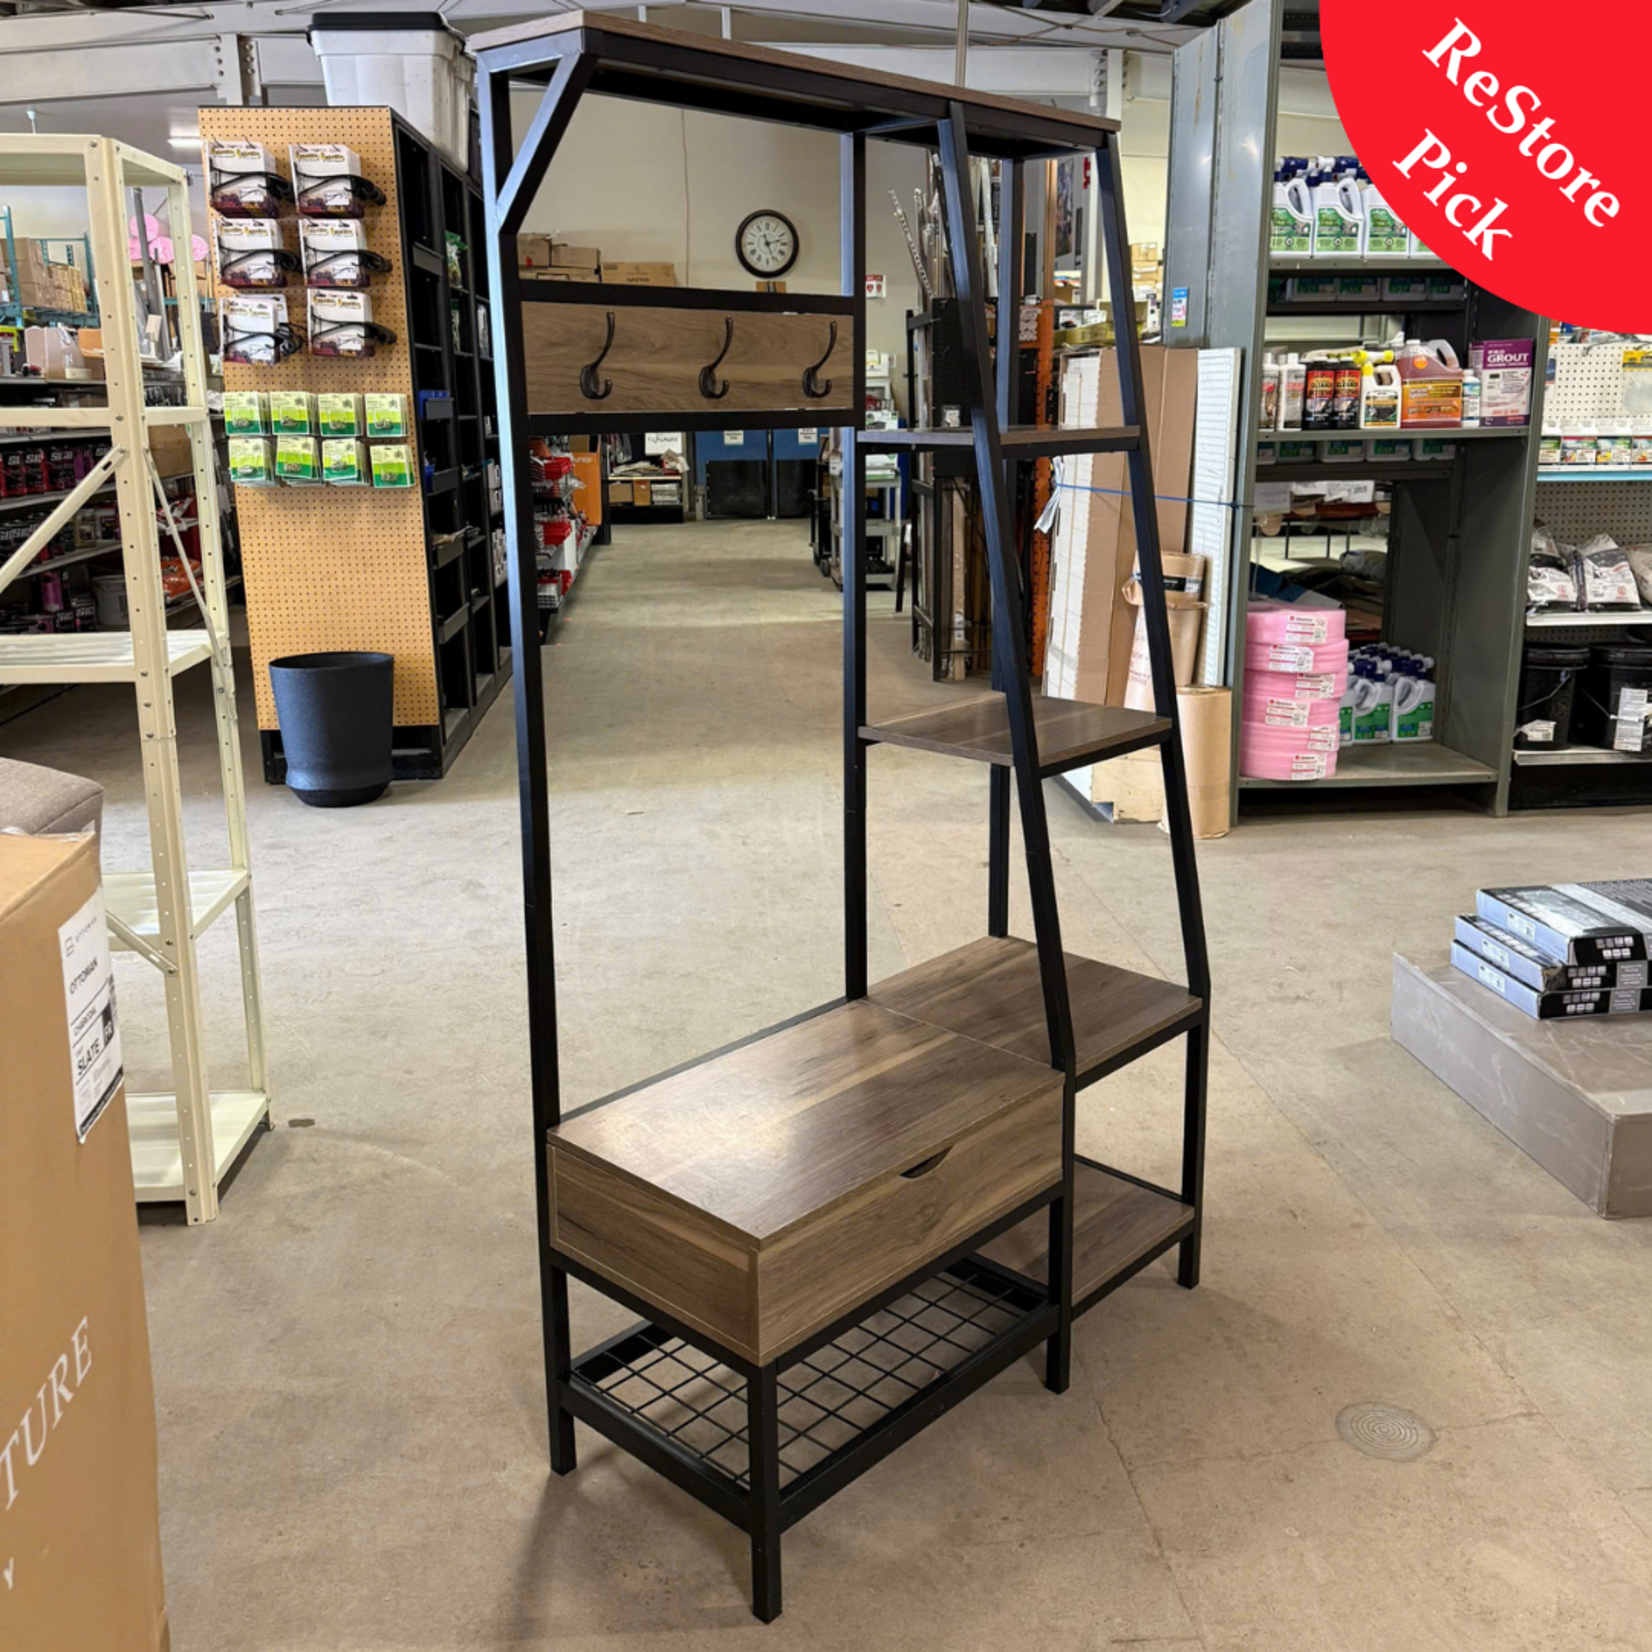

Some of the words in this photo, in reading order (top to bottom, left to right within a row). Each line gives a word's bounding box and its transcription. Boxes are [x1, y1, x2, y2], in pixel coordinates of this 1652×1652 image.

[1487, 353, 1529, 364] GROUT
[69, 956, 98, 995] OTTOMAN
[77, 1038, 99, 1076] SLATE
